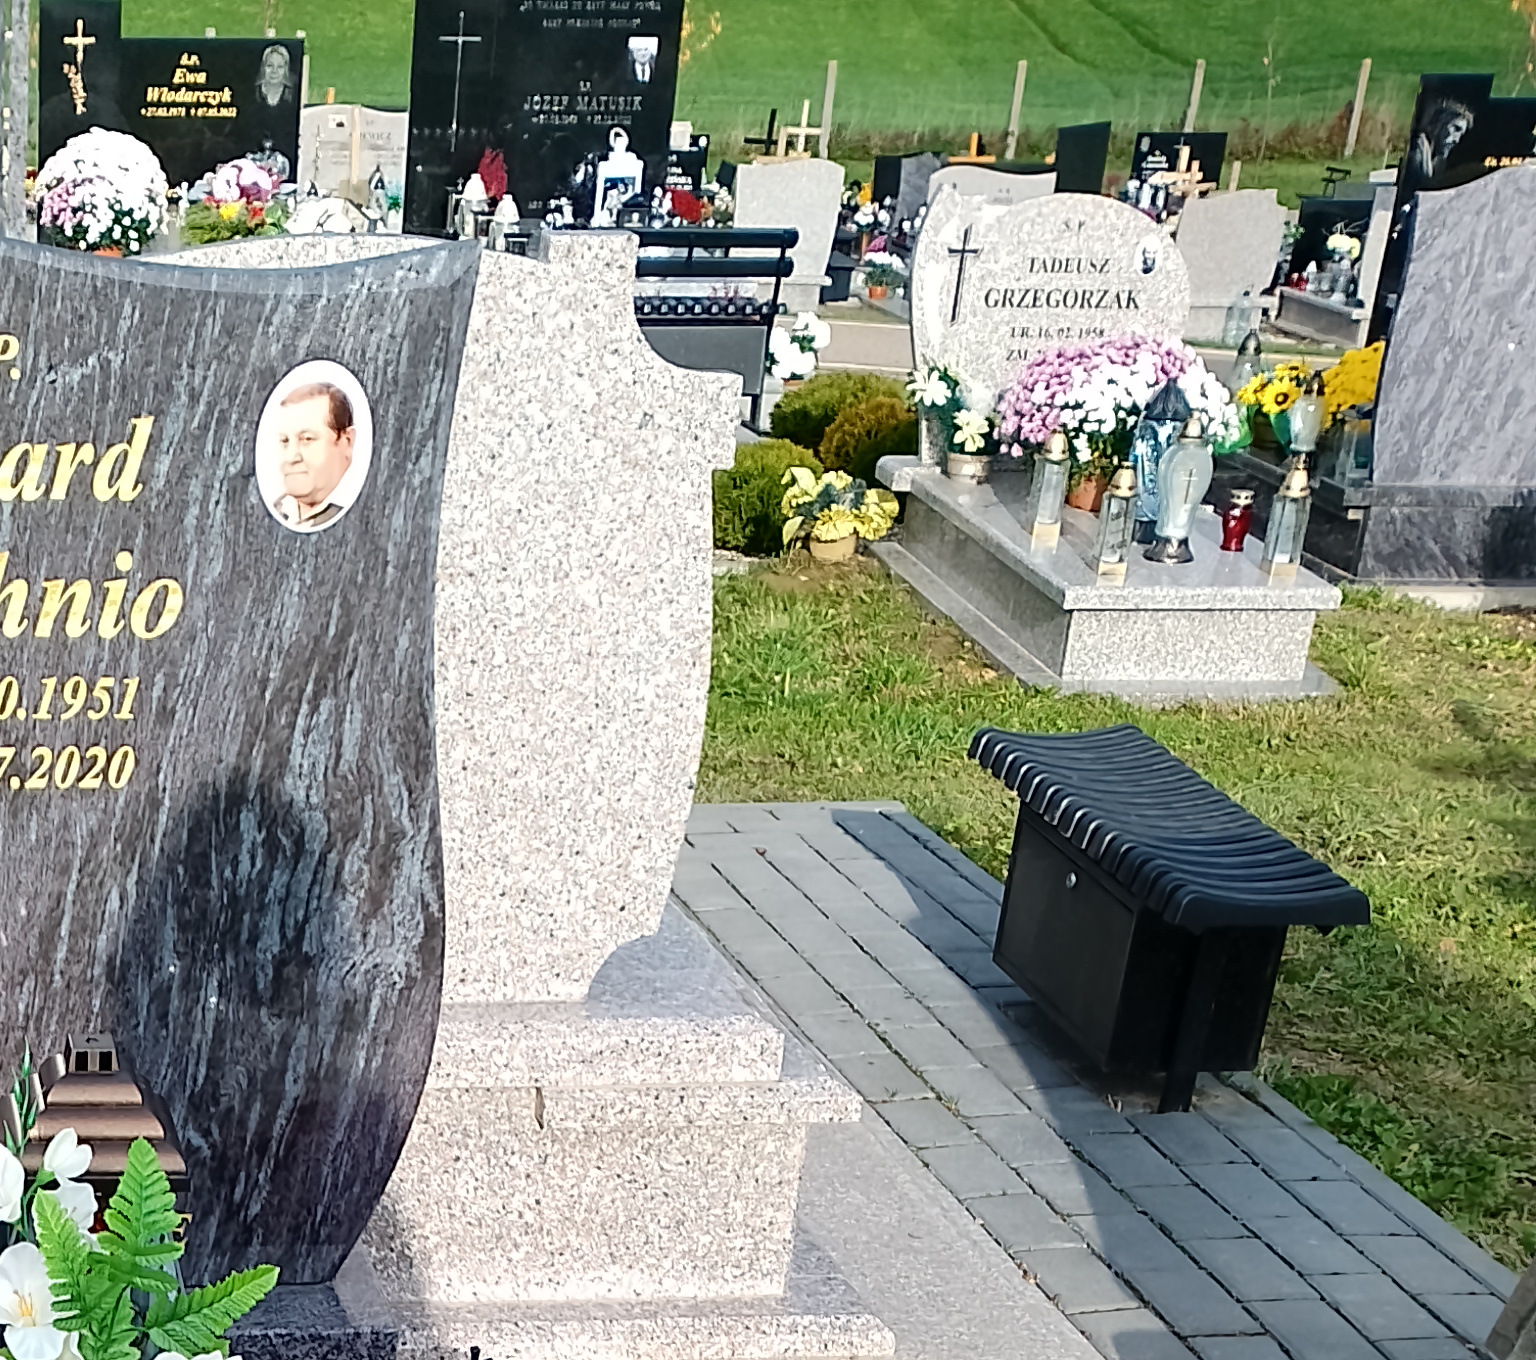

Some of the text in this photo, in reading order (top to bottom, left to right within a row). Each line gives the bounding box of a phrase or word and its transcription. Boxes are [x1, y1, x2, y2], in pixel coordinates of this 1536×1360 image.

[172, 68, 207, 84] Ewa
[576, 95, 643, 111] MATUSIK
[1028, 256, 1111, 274] TADEUSZ
[984, 287, 1142, 310] GRZEGORZAK
